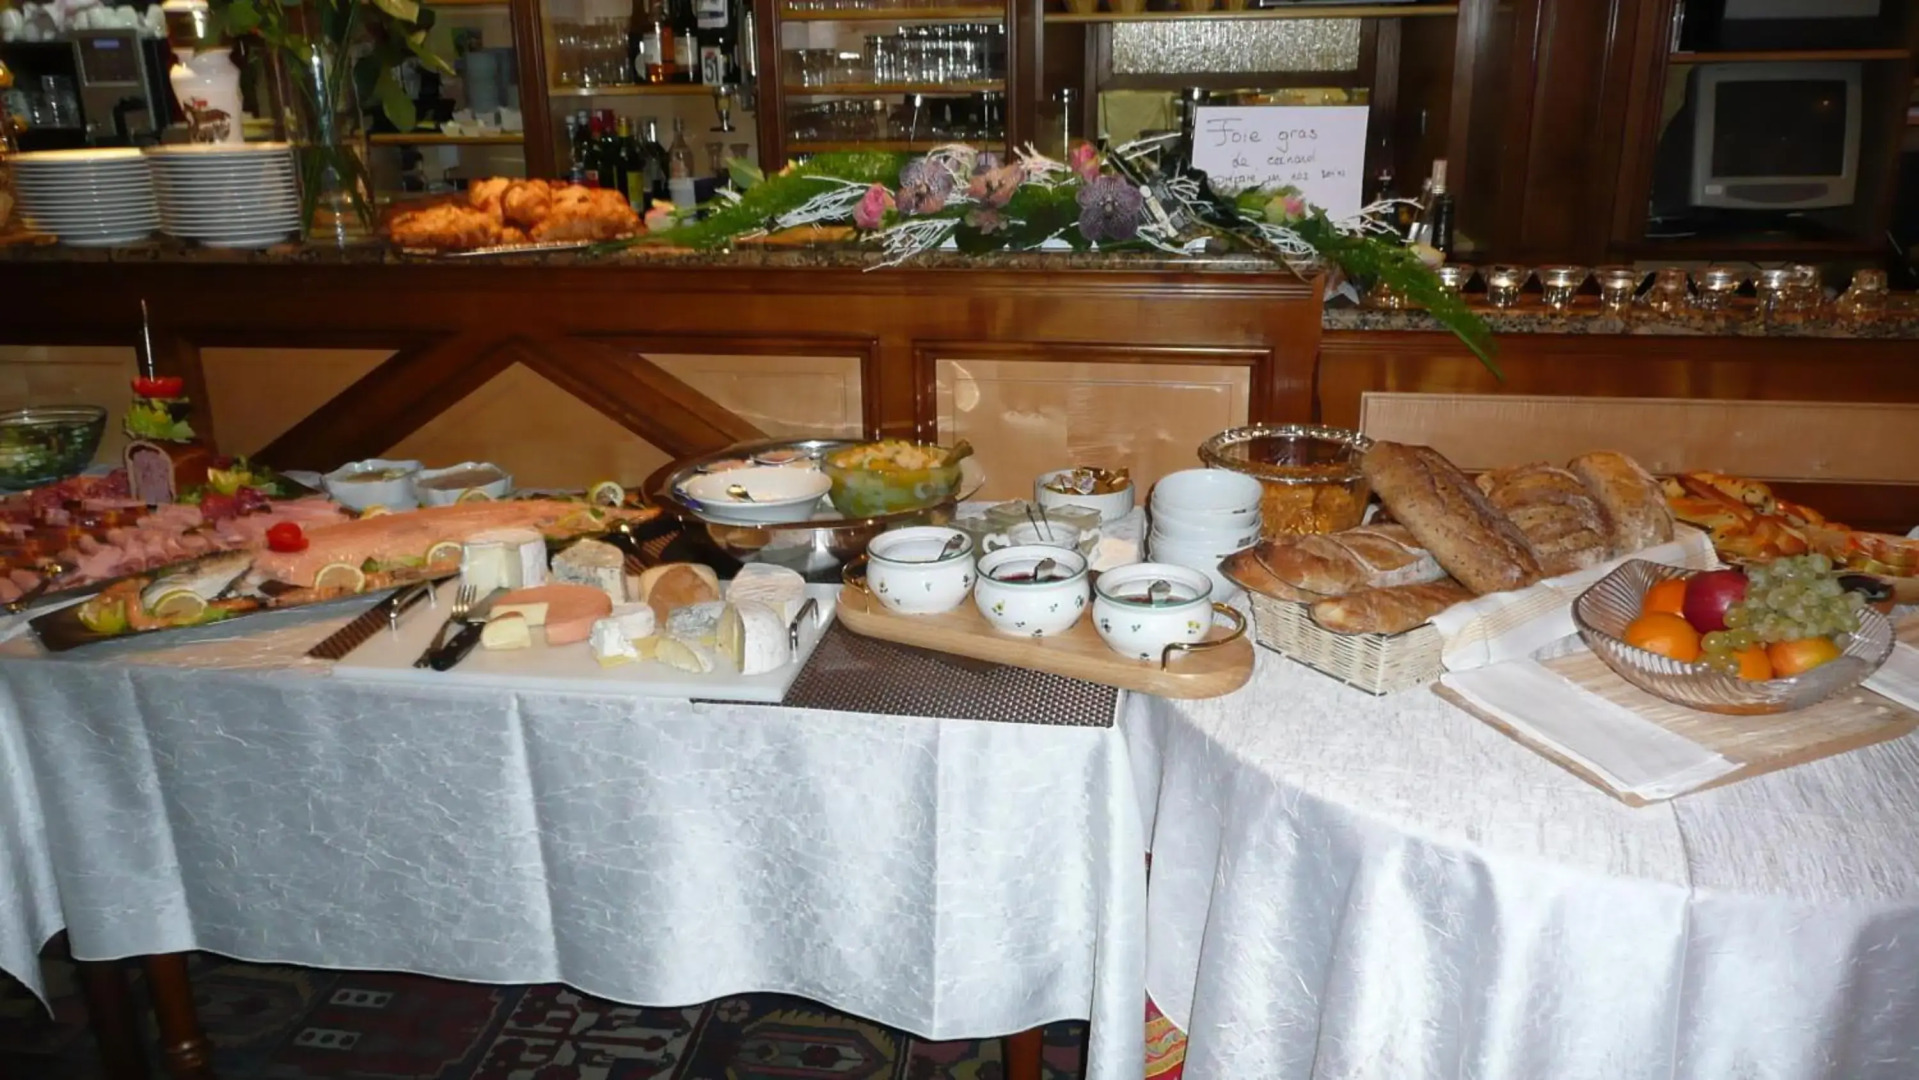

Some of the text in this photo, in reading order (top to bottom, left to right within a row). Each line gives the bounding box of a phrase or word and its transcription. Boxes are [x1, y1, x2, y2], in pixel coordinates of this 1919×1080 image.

[1206, 118, 1318, 153] Foie gras
[1232, 152, 1250, 168] de
